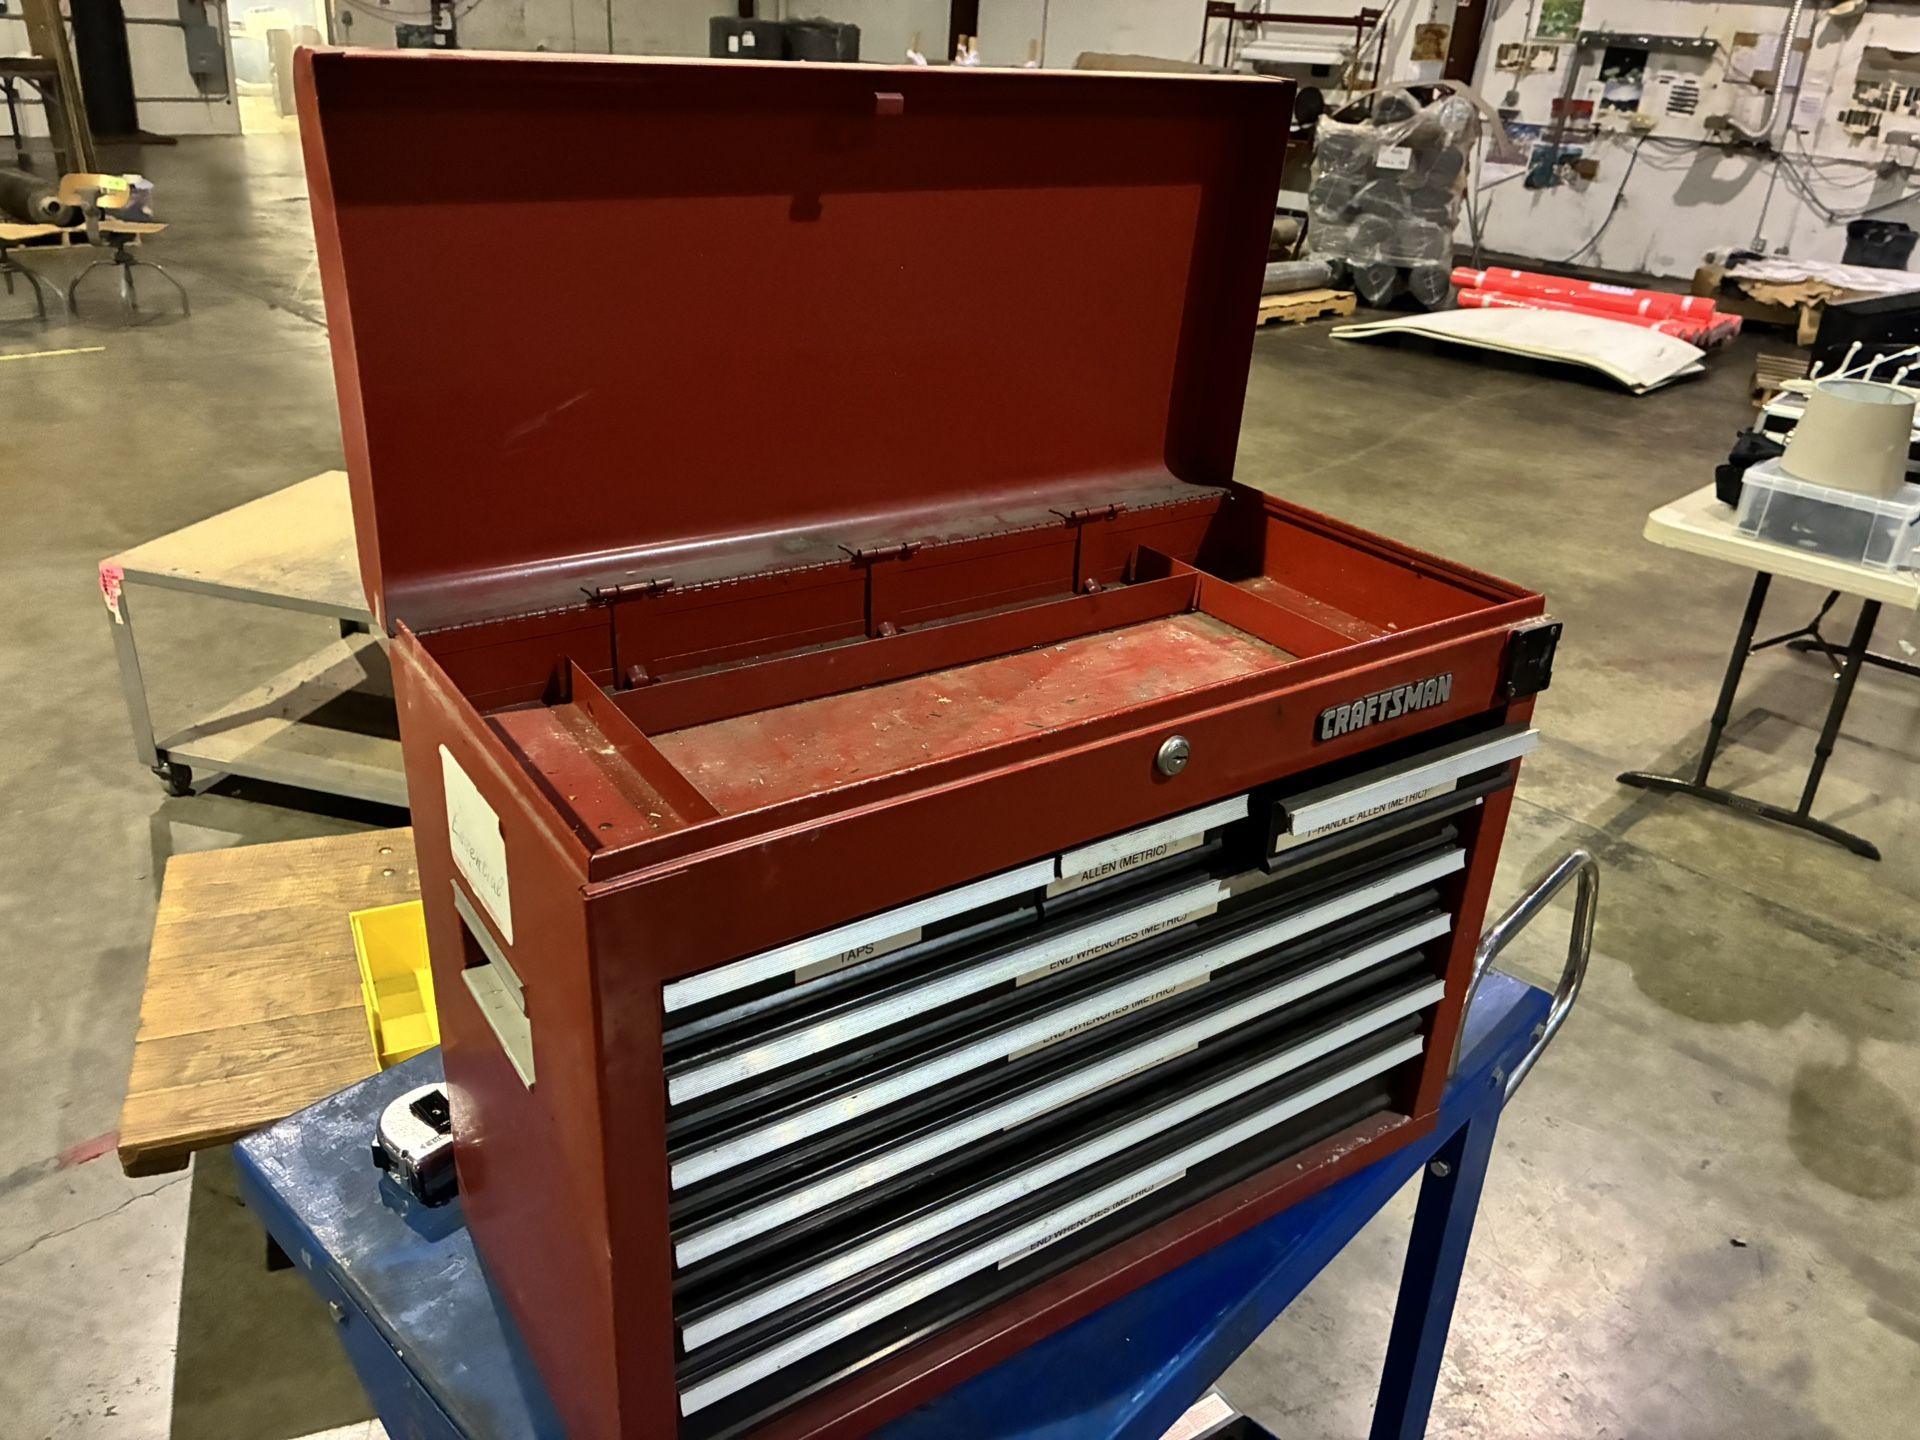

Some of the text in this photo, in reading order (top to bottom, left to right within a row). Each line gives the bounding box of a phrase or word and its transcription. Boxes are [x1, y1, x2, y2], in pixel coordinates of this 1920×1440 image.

[1320, 672, 1454, 741] CRAFTSMAN
[1356, 803, 1388, 821] ALLEN
[1387, 788, 1429, 811] (METRIC)
[1081, 843, 1168, 882] ALLEN (METRIC)
[840, 942, 875, 964] TAPS
[1049, 912, 1189, 970] END WRENCHES (METRIC)
